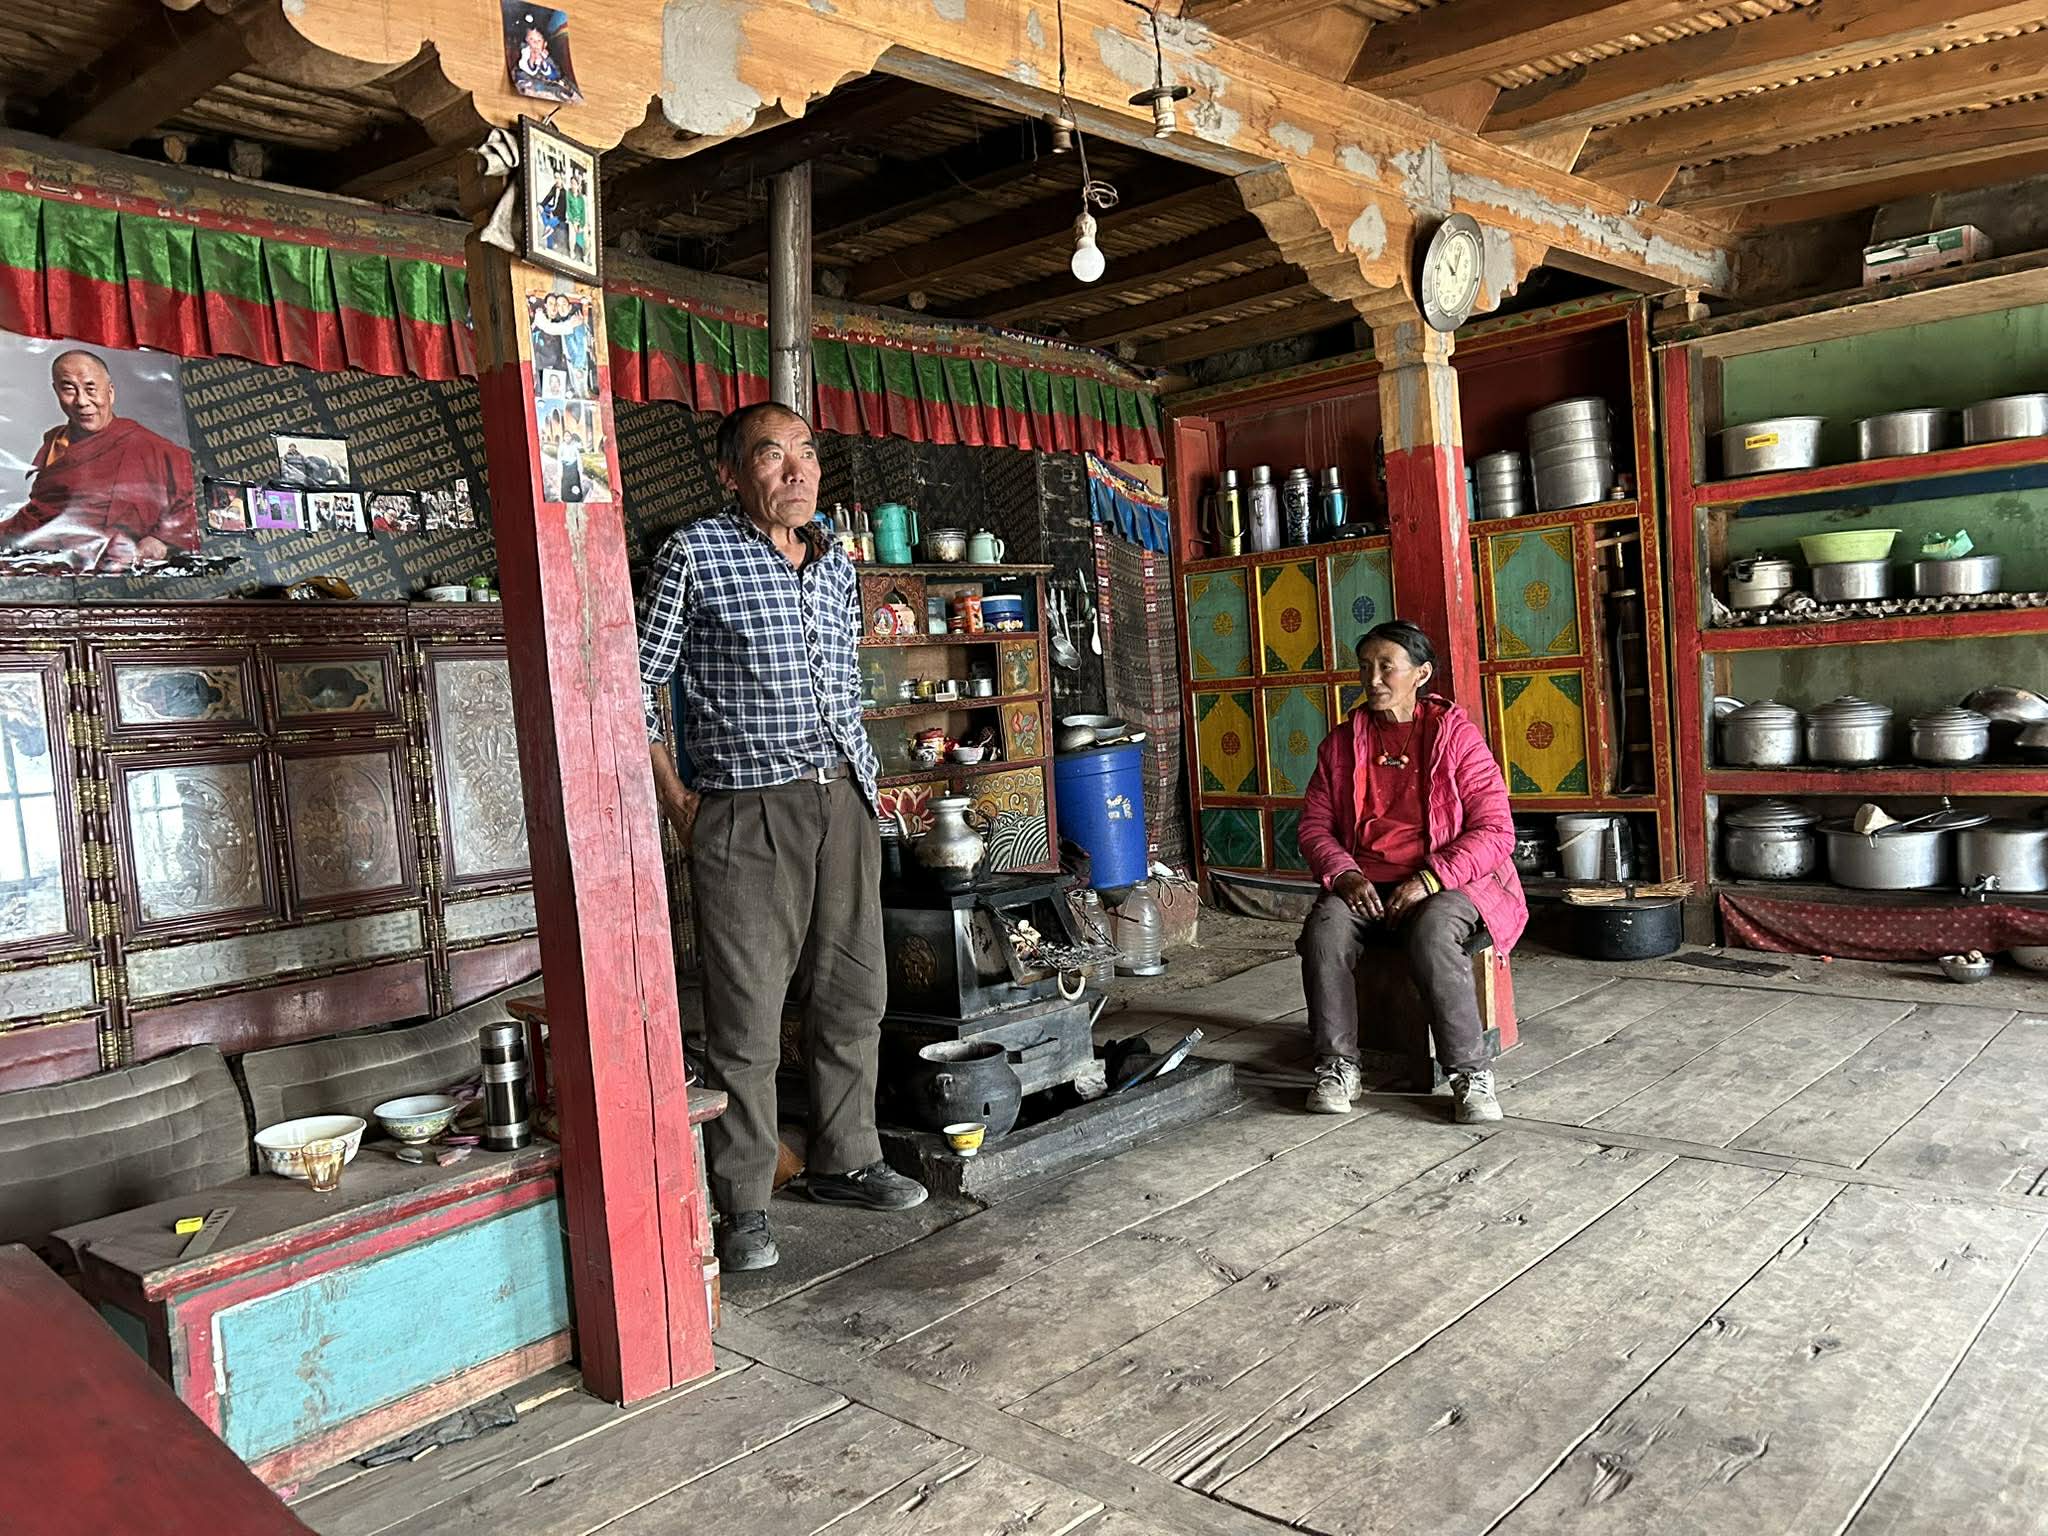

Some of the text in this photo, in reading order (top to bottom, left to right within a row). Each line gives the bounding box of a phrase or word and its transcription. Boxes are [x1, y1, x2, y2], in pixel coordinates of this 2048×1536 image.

[180, 358, 252, 386] MARINE
[184, 364, 299, 408] MARINEPLEX
[195, 383, 308, 428] MARINEPLEX
[205, 403, 318, 448] MARINEPLEX
[334, 388, 433, 430] MARINEPLEX
[352, 424, 449, 467] MARINEPLEX
[618, 417, 686, 451] ARINEPLEX
[359, 441, 456, 486] MARINEPLEX
[624, 448, 698, 487] MARINEPLEX
[630, 464, 705, 503] MARINEPLEX
[636, 479, 711, 519] MARINEPLEX
[403, 528, 495, 575] MARINEPLEX
